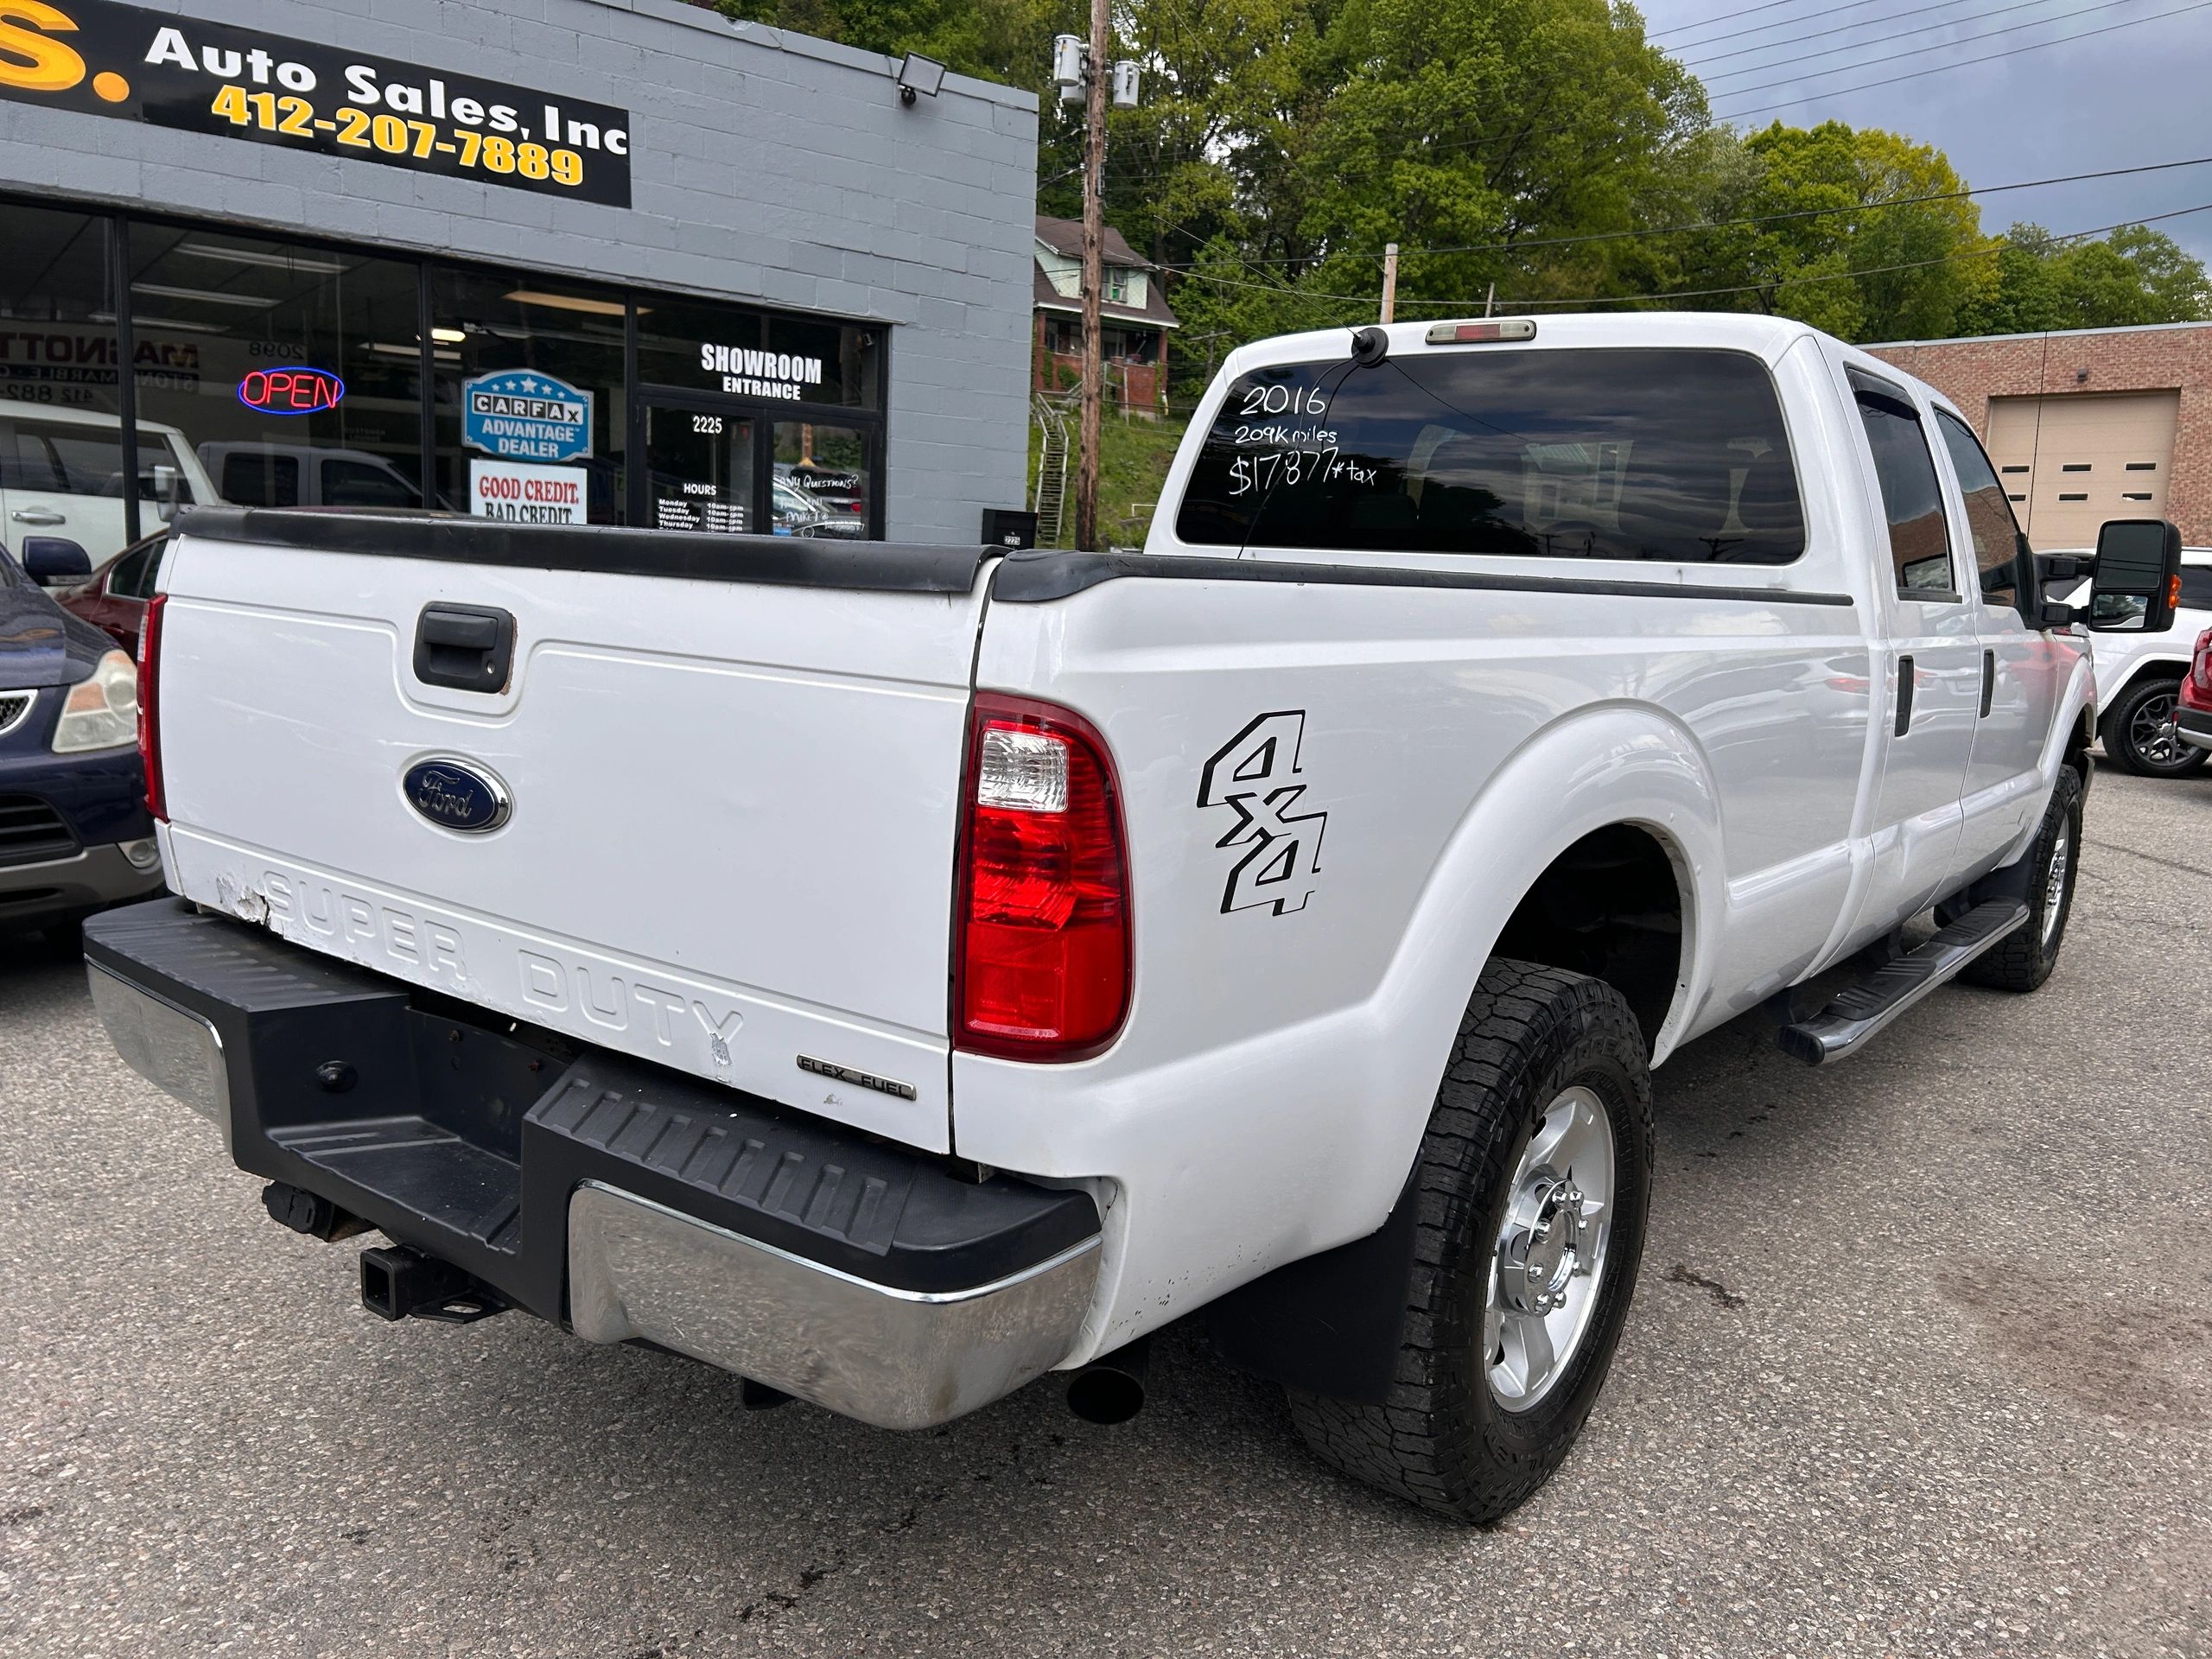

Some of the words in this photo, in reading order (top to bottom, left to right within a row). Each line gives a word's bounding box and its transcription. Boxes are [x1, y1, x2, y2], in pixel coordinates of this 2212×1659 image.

[144, 26, 317, 92] Auto
[344, 64, 530, 141] Sales,
[544, 105, 627, 156] Inc
[211, 84, 583, 186] 412-207-7889
[701, 343, 822, 385] SHOWROOM
[243, 372, 339, 409] OPEN
[722, 376, 801, 401] ENTRANCE
[1240, 385, 1325, 415] 2016
[476, 396, 579, 423] CARFAX
[692, 416, 722, 435] 2225
[498, 440, 559, 458] DEALER
[480, 475, 521, 500] GOOD
[683, 483, 717, 496] HOURS
[658, 499, 688, 508] Monday
[658, 506, 690, 515] Tuesday
[658, 512, 701, 523] Wednesday
[658, 520, 694, 530] Thursday
[418, 769, 474, 819] Ford
[264, 869, 468, 982] SUPER
[519, 948, 745, 1065] DUTY
[801, 1058, 847, 1081] FLEX
[861, 1075, 908, 1098] FUEL
